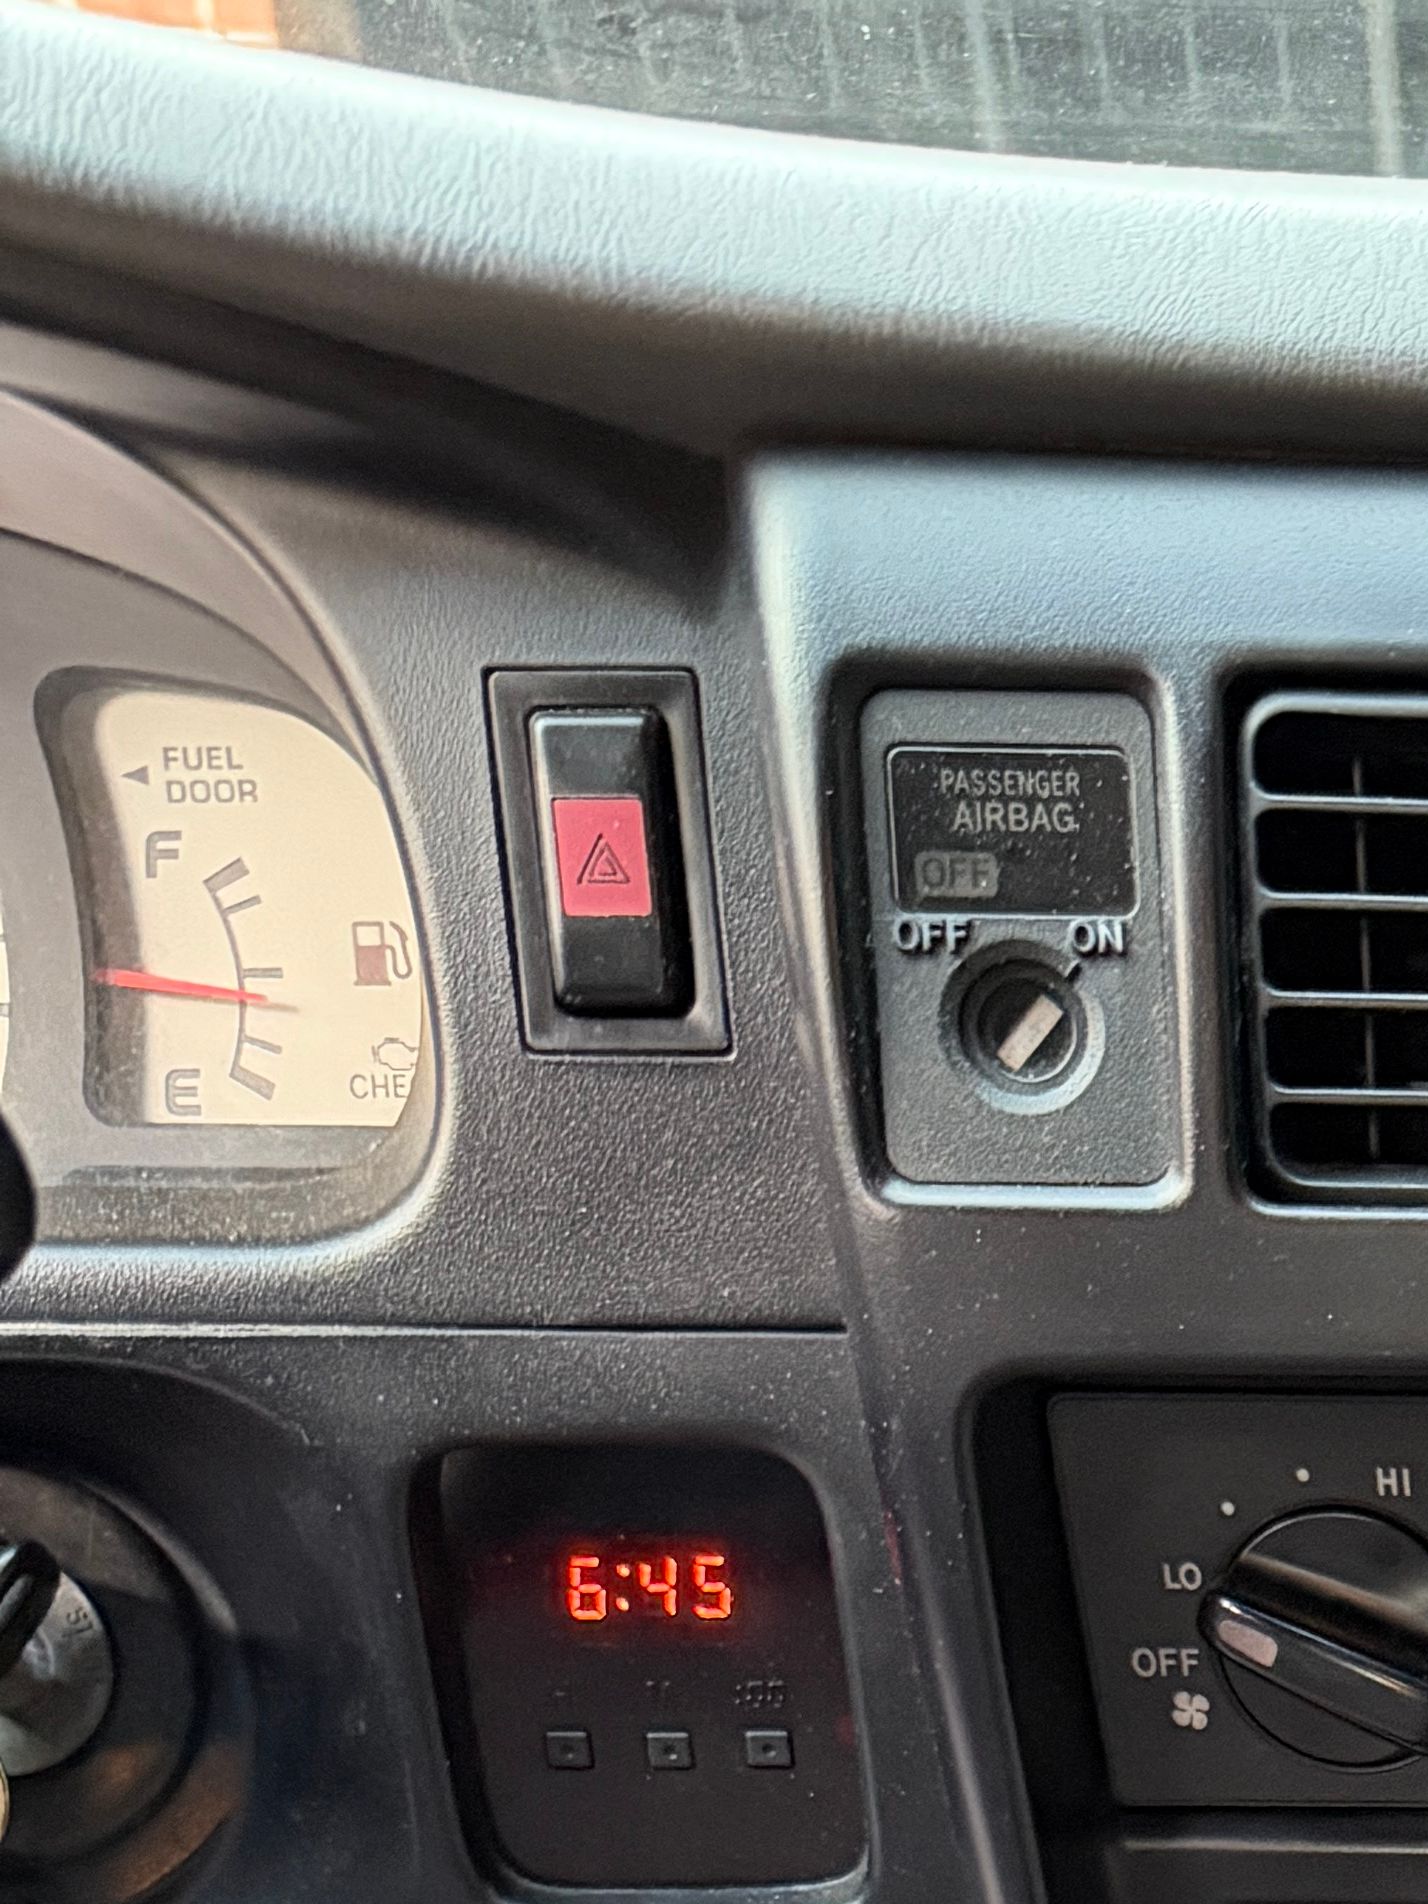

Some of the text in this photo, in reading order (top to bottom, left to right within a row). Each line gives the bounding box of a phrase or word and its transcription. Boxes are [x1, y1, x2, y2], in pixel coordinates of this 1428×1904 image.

[162, 746, 243, 771] FUEL
[165, 779, 259, 804] DOOR
[939, 769, 1080, 797] PASSENGER
[953, 803, 1077, 833] AIRBAG
[145, 830, 182, 879] F
[922, 859, 991, 890] OFF
[896, 920, 971, 952] OFF
[1070, 920, 1126, 956] ON
[164, 1068, 202, 1117] E
[1376, 1467, 1411, 1497] HI
[567, 1556, 732, 1621] 6:45
[1163, 1564, 1202, 1592] LO
[1131, 1647, 1200, 1679] OFF
